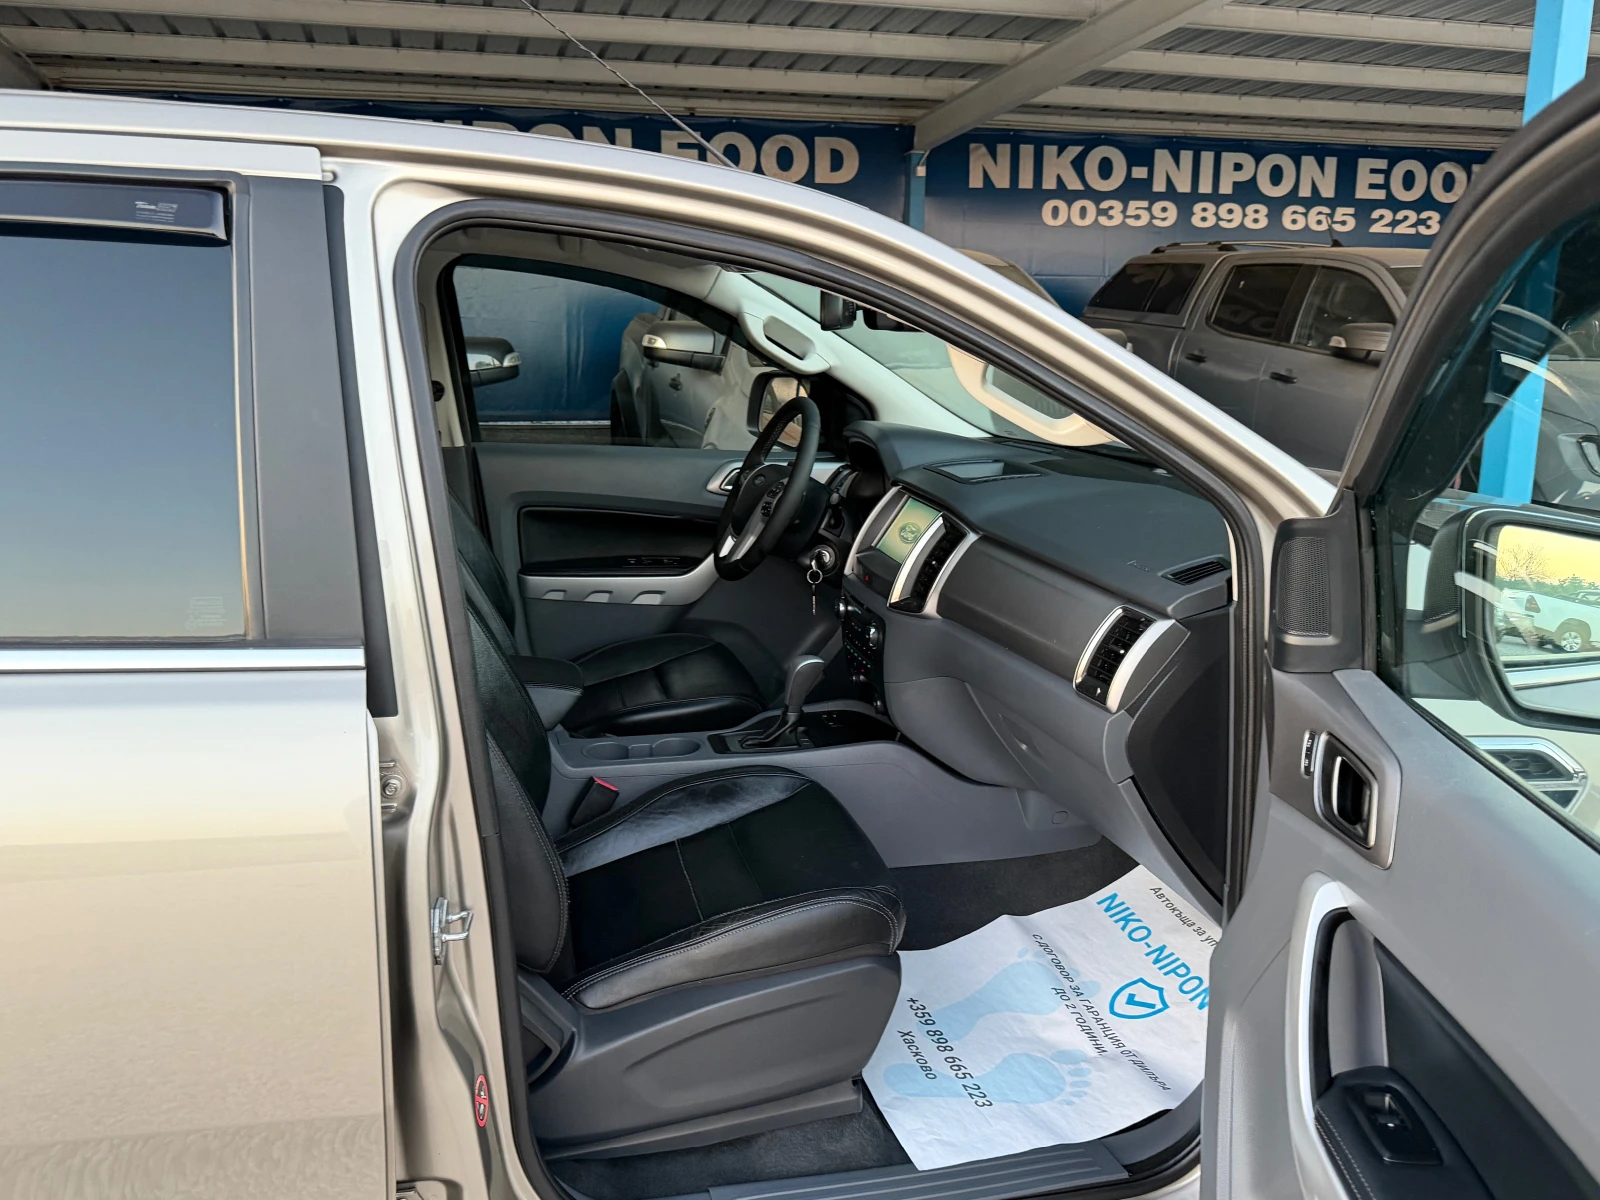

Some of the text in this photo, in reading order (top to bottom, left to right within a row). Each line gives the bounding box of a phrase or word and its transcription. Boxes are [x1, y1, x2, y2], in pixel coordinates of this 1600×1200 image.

[660, 130, 860, 184] EOOD
[968, 143, 1487, 204] NIKO-NIPON EOO
[1041, 199, 1441, 236] 00359 898 665 223
[1149, 886, 1196, 928] Автокъща
[1192, 926, 1207, 937] за
[1035, 940, 1075, 984] ДОГОВОР
[1069, 984, 1085, 998] ЗА
[1078, 999, 1126, 1049] ГАРАНЦИЯ
[1120, 1049, 1139, 1059] ОТ
[1050, 987, 1071, 1002] ДО
[896, 1029, 938, 1080] Хасково
[906, 997, 993, 1108] +359 898 665 223
